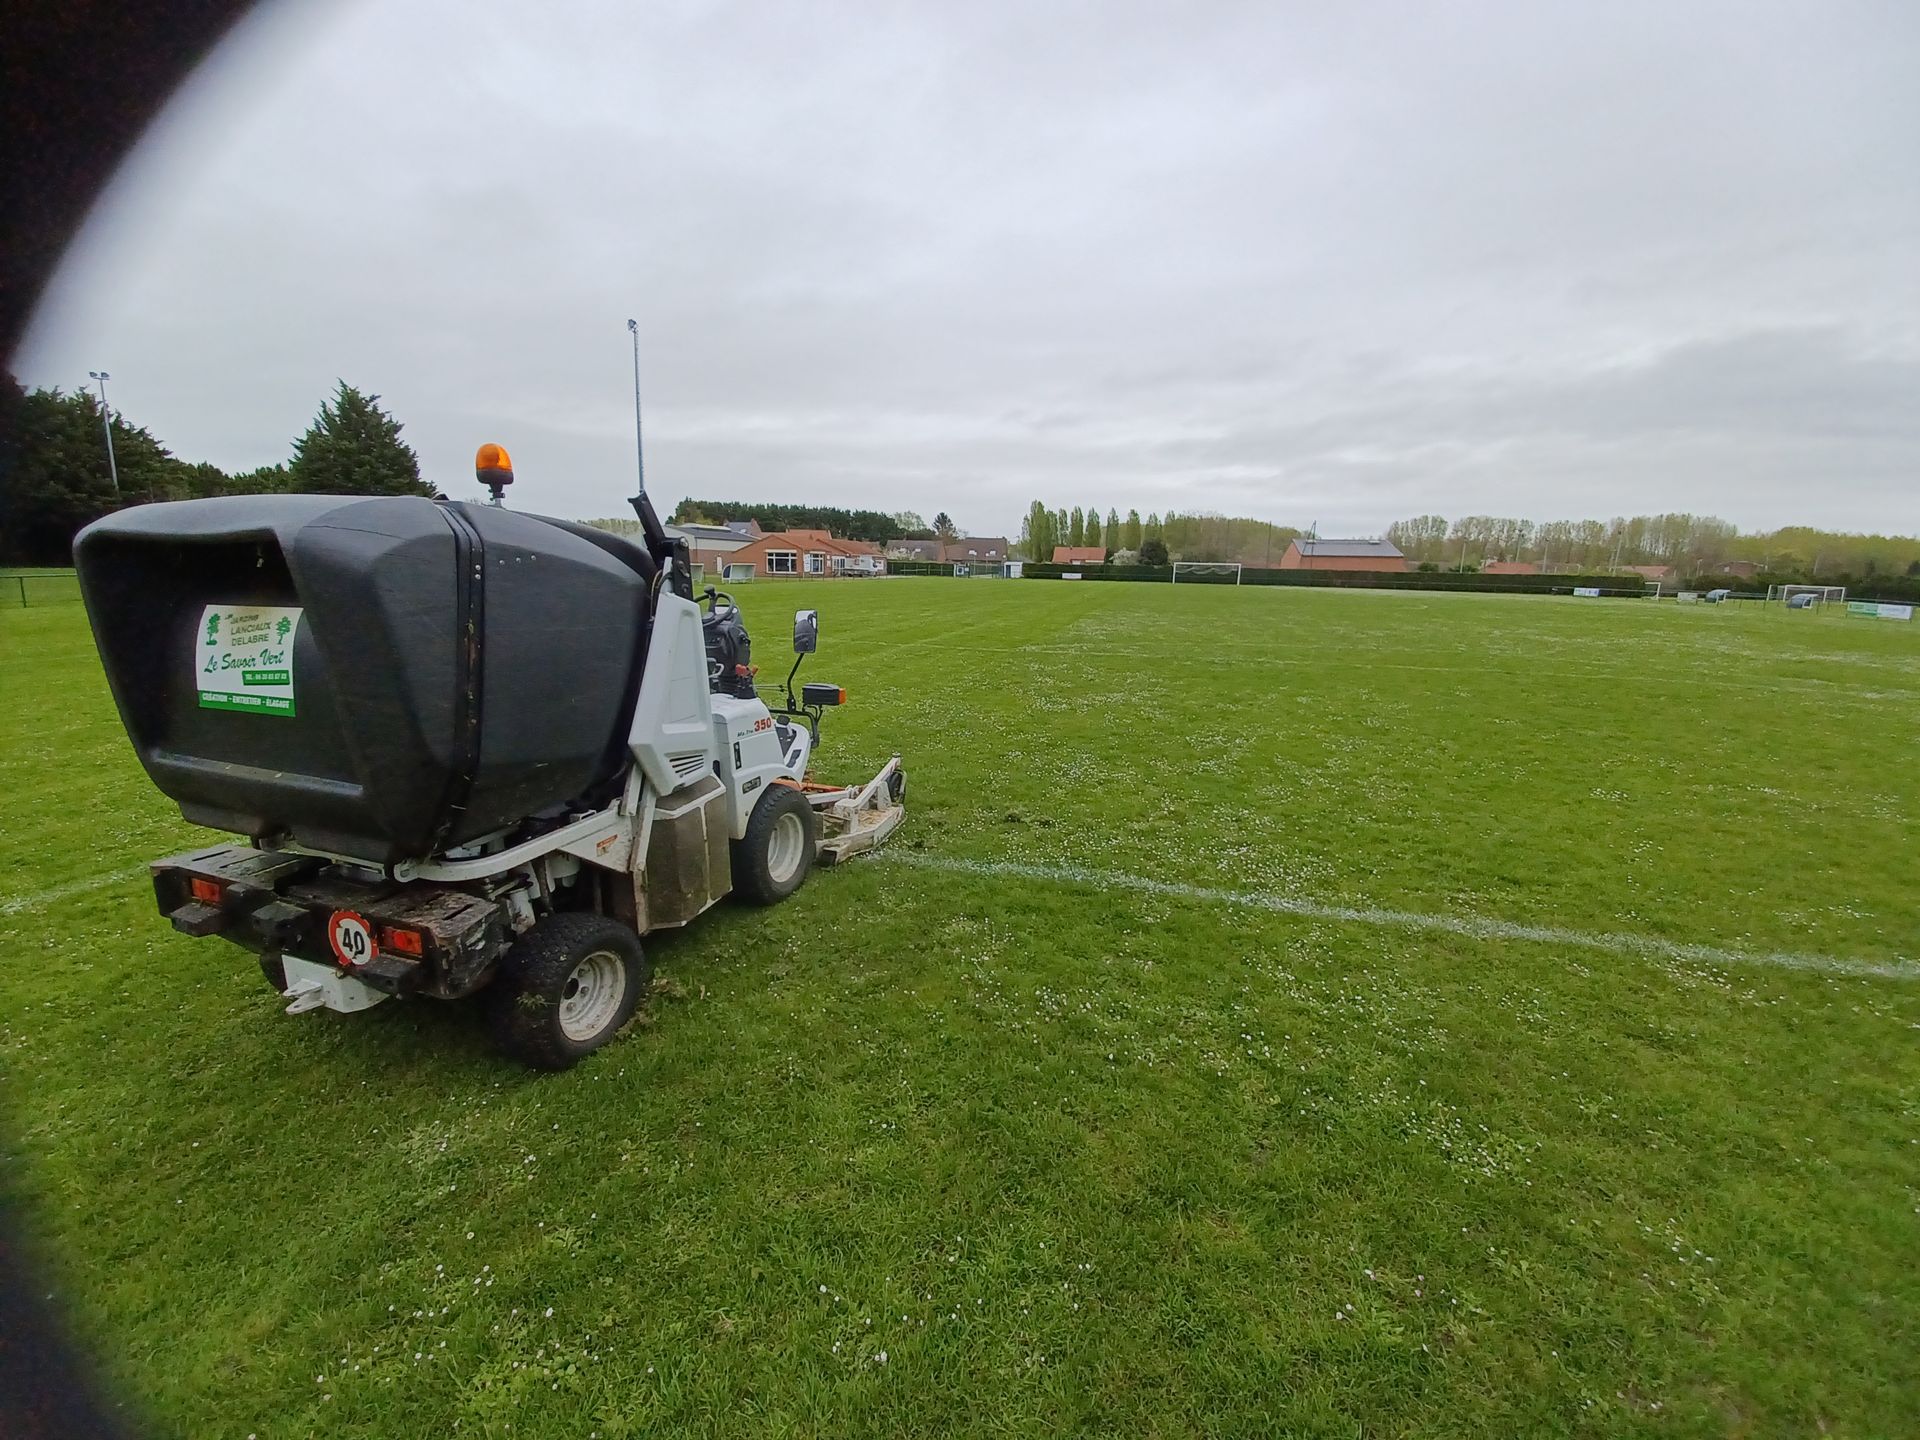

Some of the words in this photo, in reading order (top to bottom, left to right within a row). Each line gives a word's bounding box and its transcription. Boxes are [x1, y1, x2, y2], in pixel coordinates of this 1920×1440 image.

[231, 634, 269, 646] DELABRE
[204, 655, 218, 673] Le
[221, 653, 257, 670] Savoir
[260, 648, 284, 666] Vert
[754, 717, 772, 732] 350
[342, 927, 366, 956] 40
